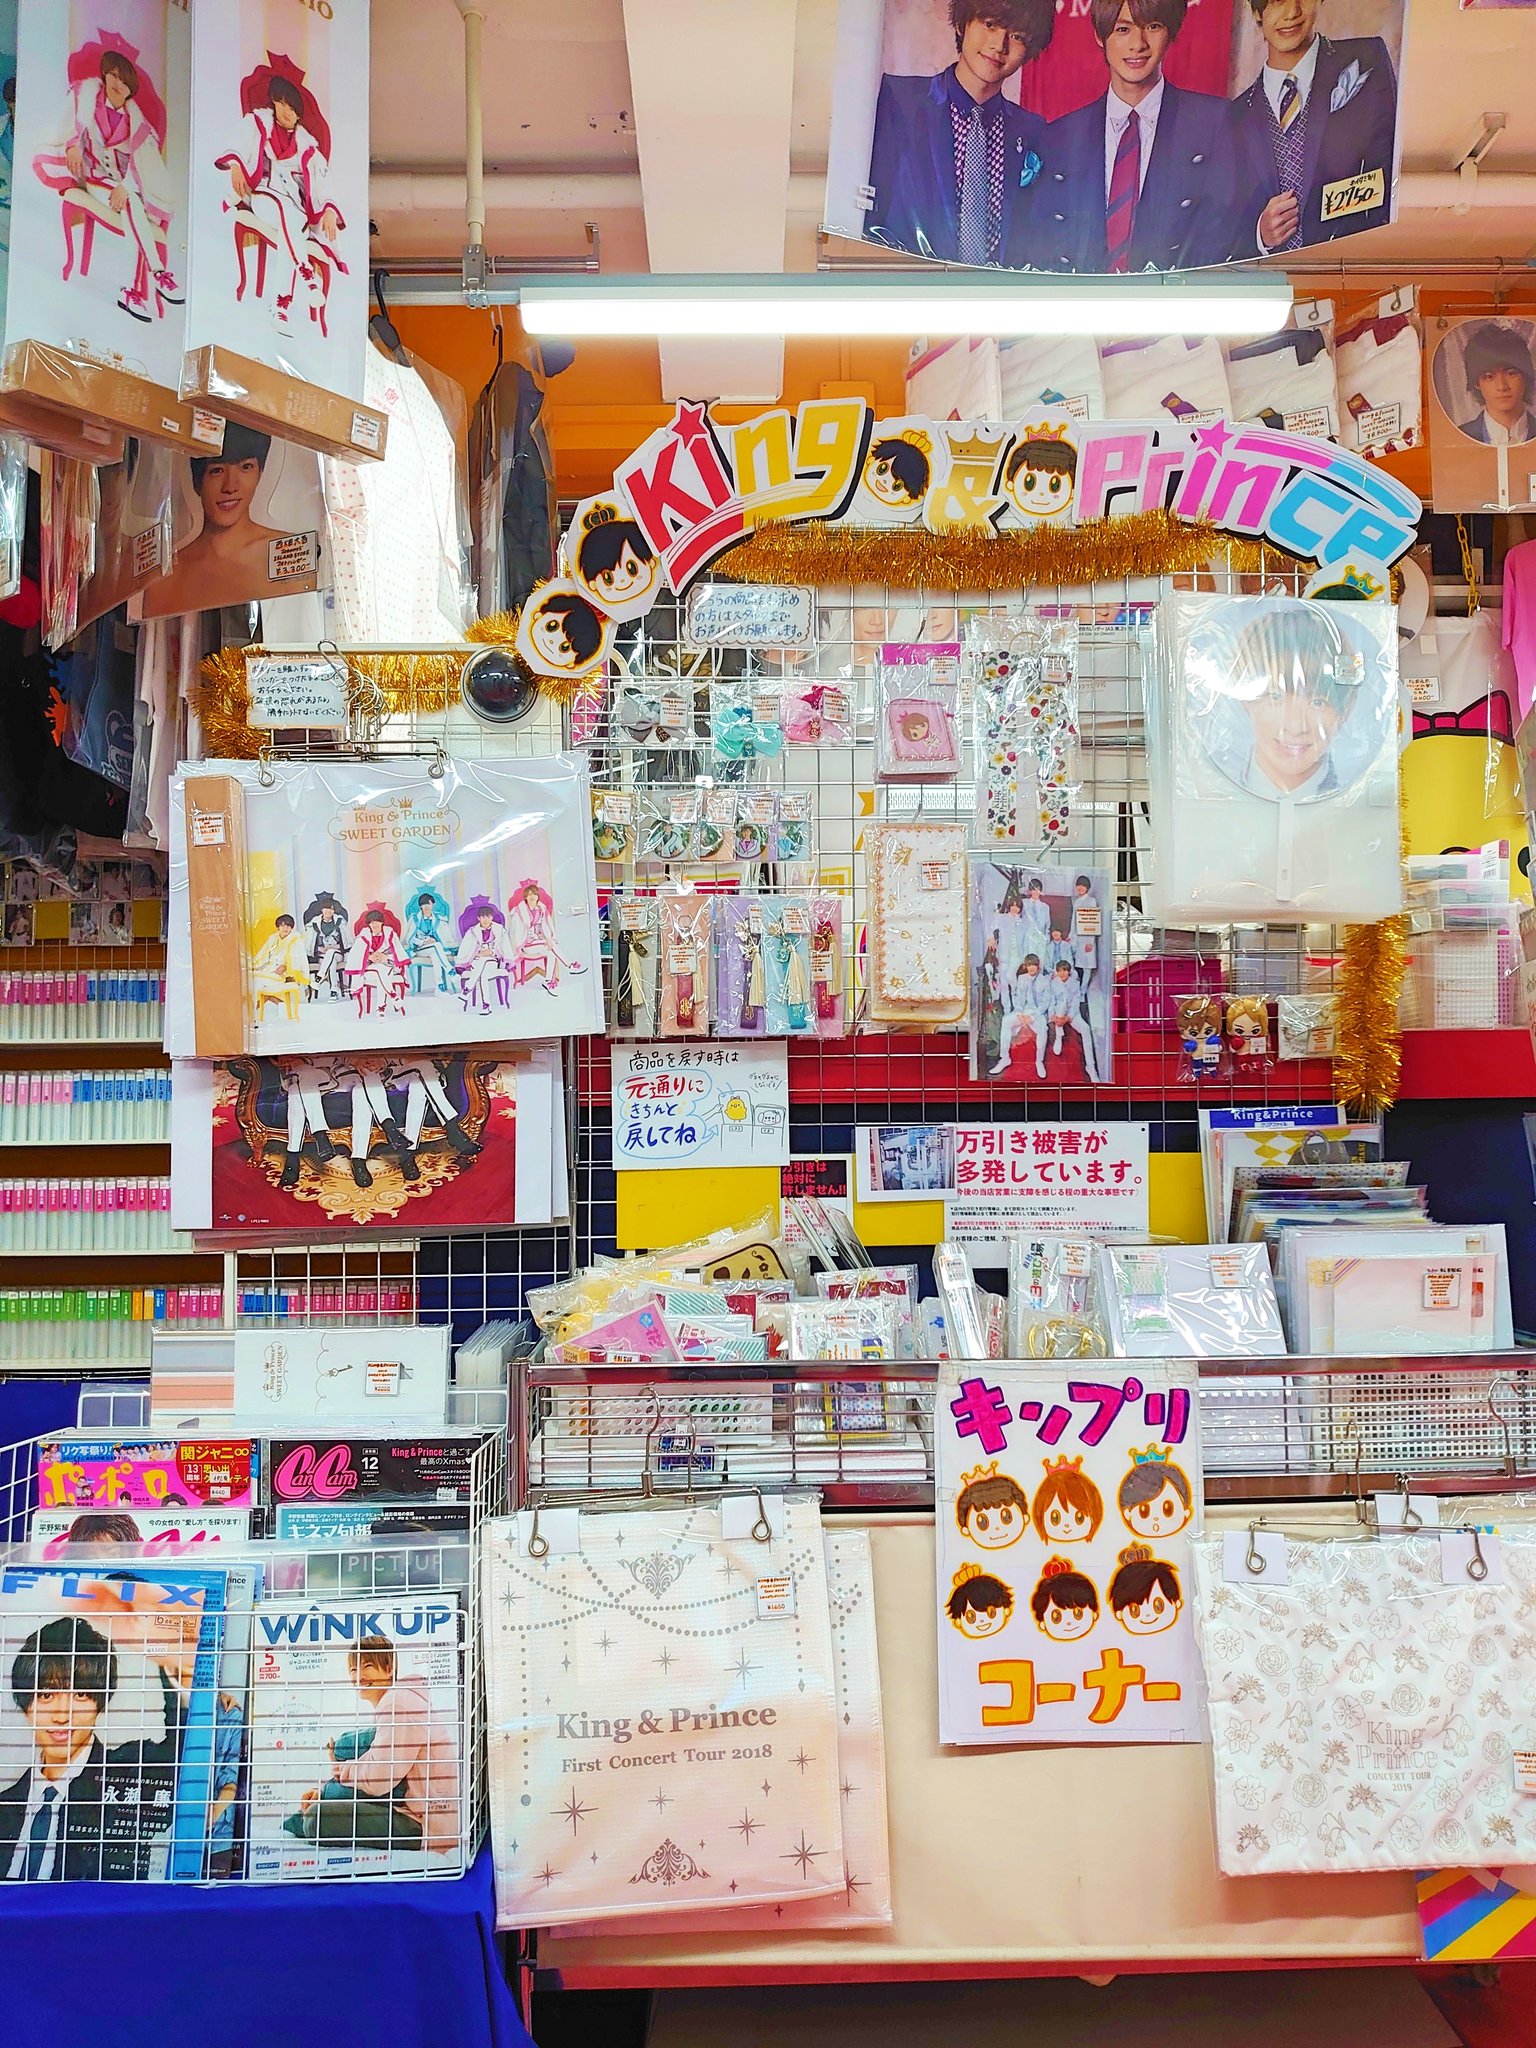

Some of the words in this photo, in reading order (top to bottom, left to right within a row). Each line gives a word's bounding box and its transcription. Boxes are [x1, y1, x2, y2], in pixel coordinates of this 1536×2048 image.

[625, 404, 864, 548] King
[1079, 420, 1409, 564] Prince
[355, 811, 384, 824] King
[387, 810, 400, 822] &
[400, 810, 445, 820] Prince
[340, 828, 387, 841] SWEET
[391, 825, 451, 839] GARDEN
[629, 1049, 740, 1072] 商品を戻す時は
[625, 1074, 704, 1100] 元通りに
[630, 1102, 678, 1119] きちんと
[624, 1122, 697, 1150] 戻してね
[956, 1129, 1108, 1155] 万引き被害が
[782, 1174, 816, 1184] 絶対に
[957, 1159, 1142, 1185] 多発しています。
[361, 1456, 379, 1470] 12
[391, 1447, 410, 1458] King
[410, 1447, 416, 1457] &
[187, 1464, 199, 1473] 13
[274, 1444, 358, 1500] CanCam
[2, 1574, 206, 1607] FLIX
[394, 1604, 453, 1636] UP
[979, 1647, 1182, 1727] コーナー
[556, 1711, 632, 1743] King
[638, 1710, 665, 1736] &
[669, 1703, 777, 1733] Prince
[1367, 1721, 1426, 1748] King
[562, 1757, 603, 1774] First
[609, 1750, 677, 1771] Concert
[683, 1747, 727, 1764] Tour
[731, 1744, 773, 1761] 2018
[1356, 1745, 1439, 1770] Prince
[1367, 1772, 1409, 1781] CONCERT
[1411, 1771, 1432, 1780] TOUR
[1392, 1783, 1412, 1792] 2019
